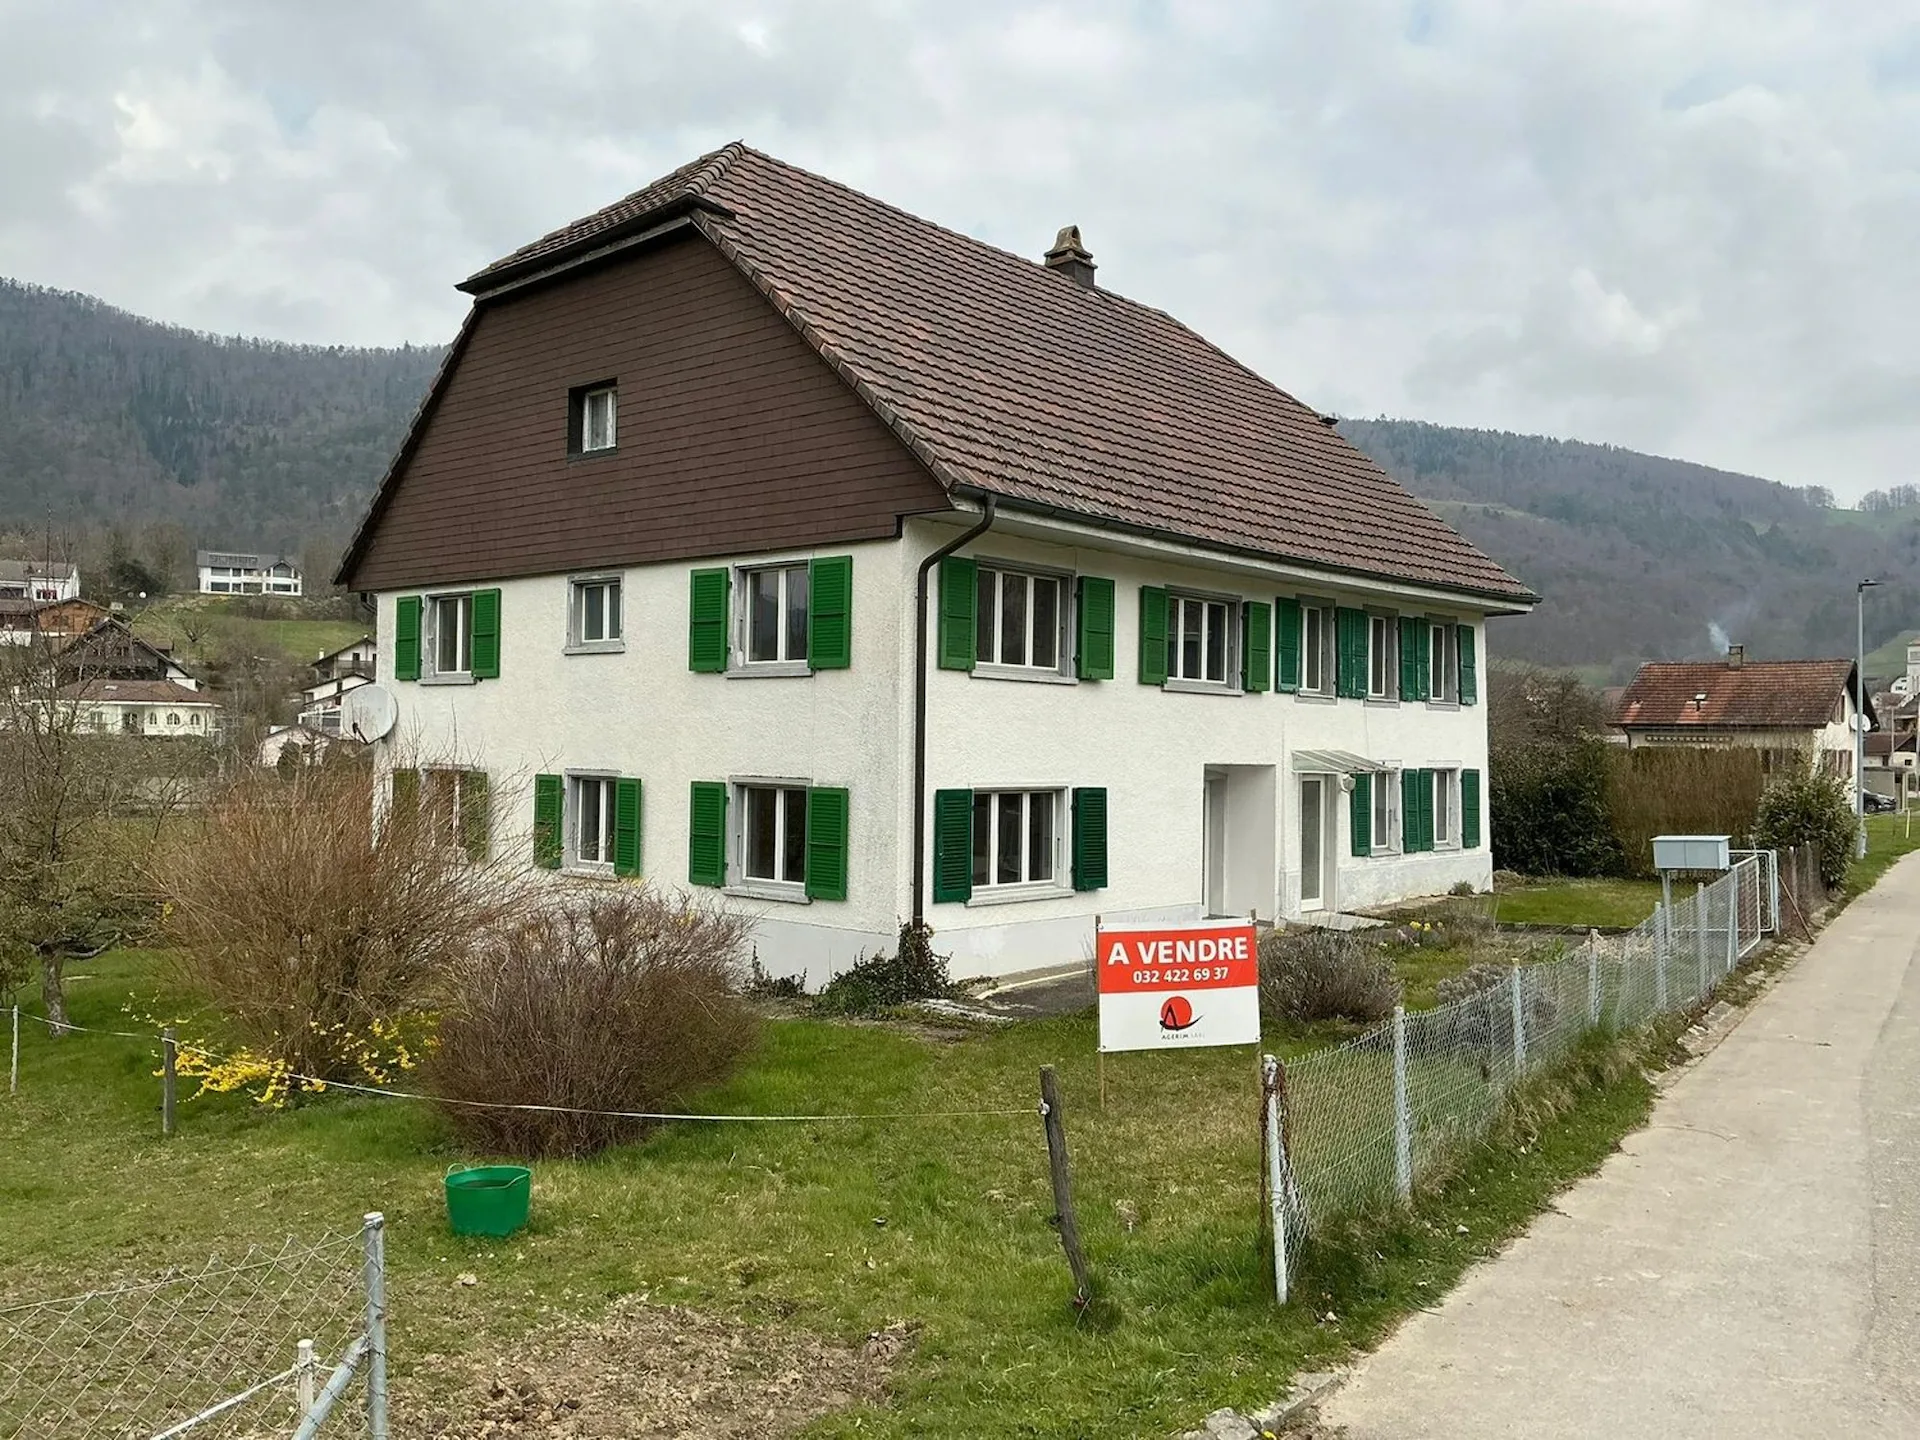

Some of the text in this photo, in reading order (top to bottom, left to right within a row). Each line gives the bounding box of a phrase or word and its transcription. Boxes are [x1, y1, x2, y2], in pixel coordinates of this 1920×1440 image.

[1107, 937, 1249, 965] A VENDRE
[1133, 967, 1229, 983] 032 422 69 37
